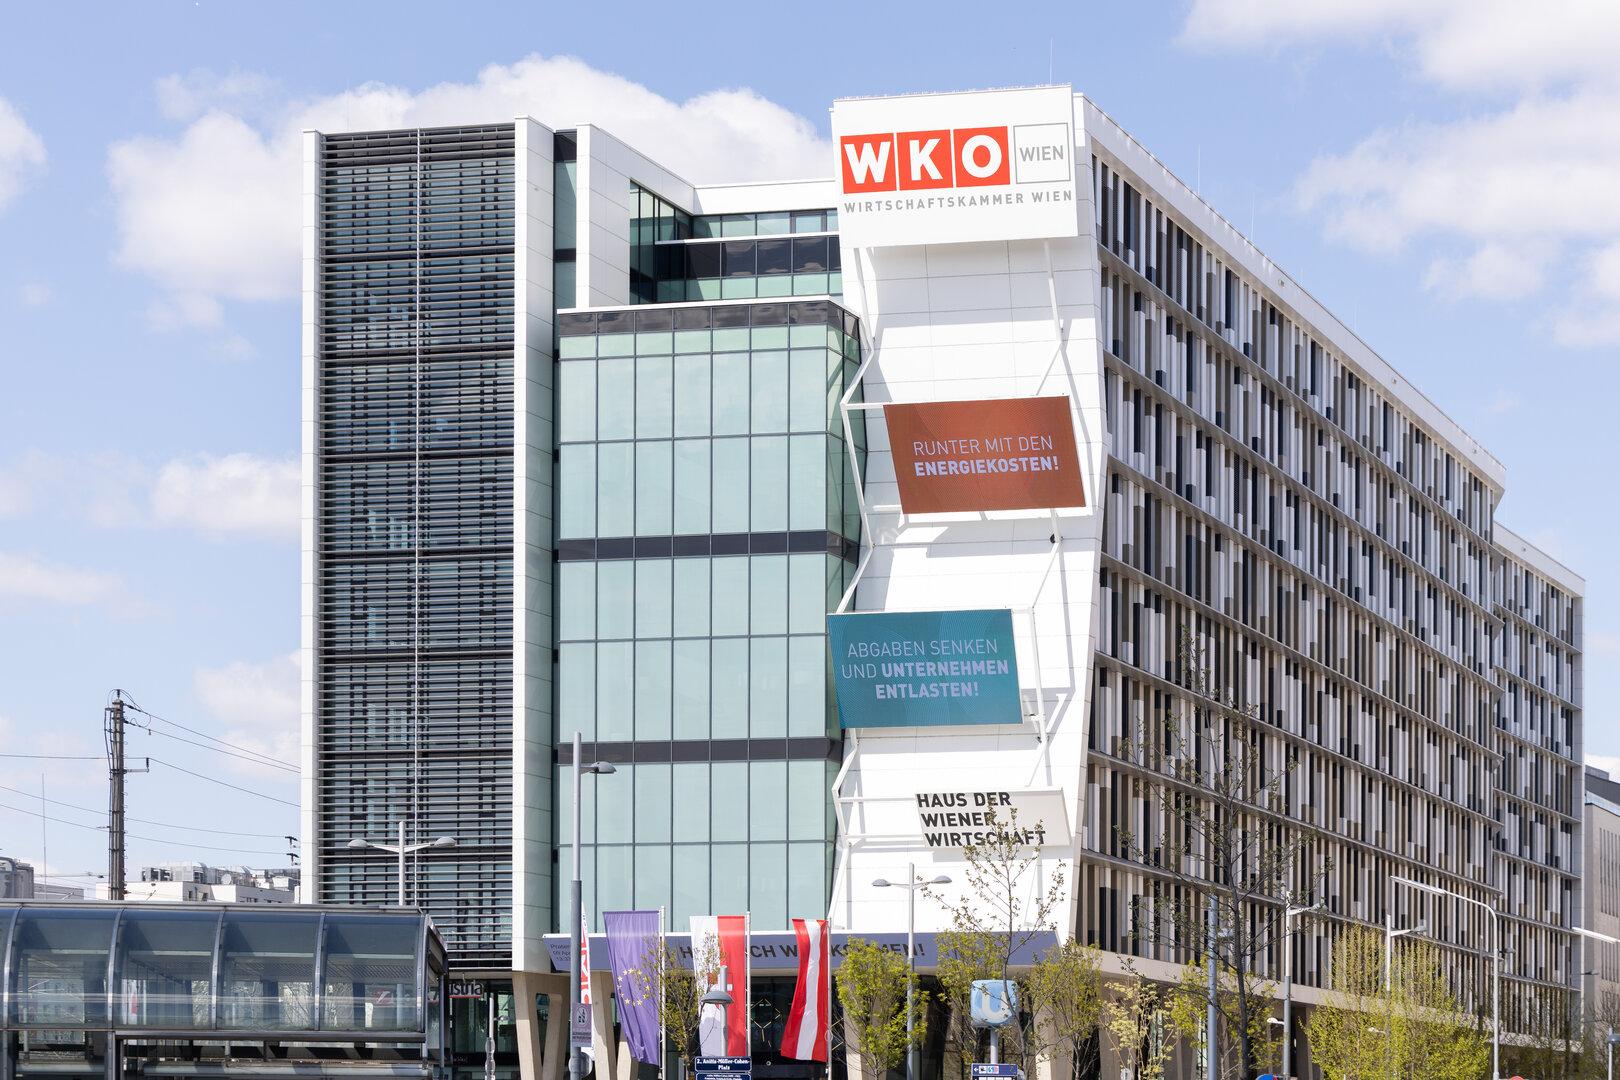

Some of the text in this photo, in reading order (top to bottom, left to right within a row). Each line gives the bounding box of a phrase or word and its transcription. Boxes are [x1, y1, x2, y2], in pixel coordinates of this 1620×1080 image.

[844, 134, 1064, 184] WKO WIEN
[844, 190, 1073, 213] WIRTSCHAFTSKAMMER WIEN
[913, 435, 1053, 456] RUNTER MIT DEN
[914, 456, 1059, 477] ENERGIEKOSTEN!
[847, 638, 998, 658] ABGABEN SENKEN
[841, 659, 1009, 679] UND UNTERNEHMEN
[875, 682, 979, 700] ENTLASTEN!
[916, 791, 1012, 808] HAUS DER
[920, 812, 997, 827] WIENER
